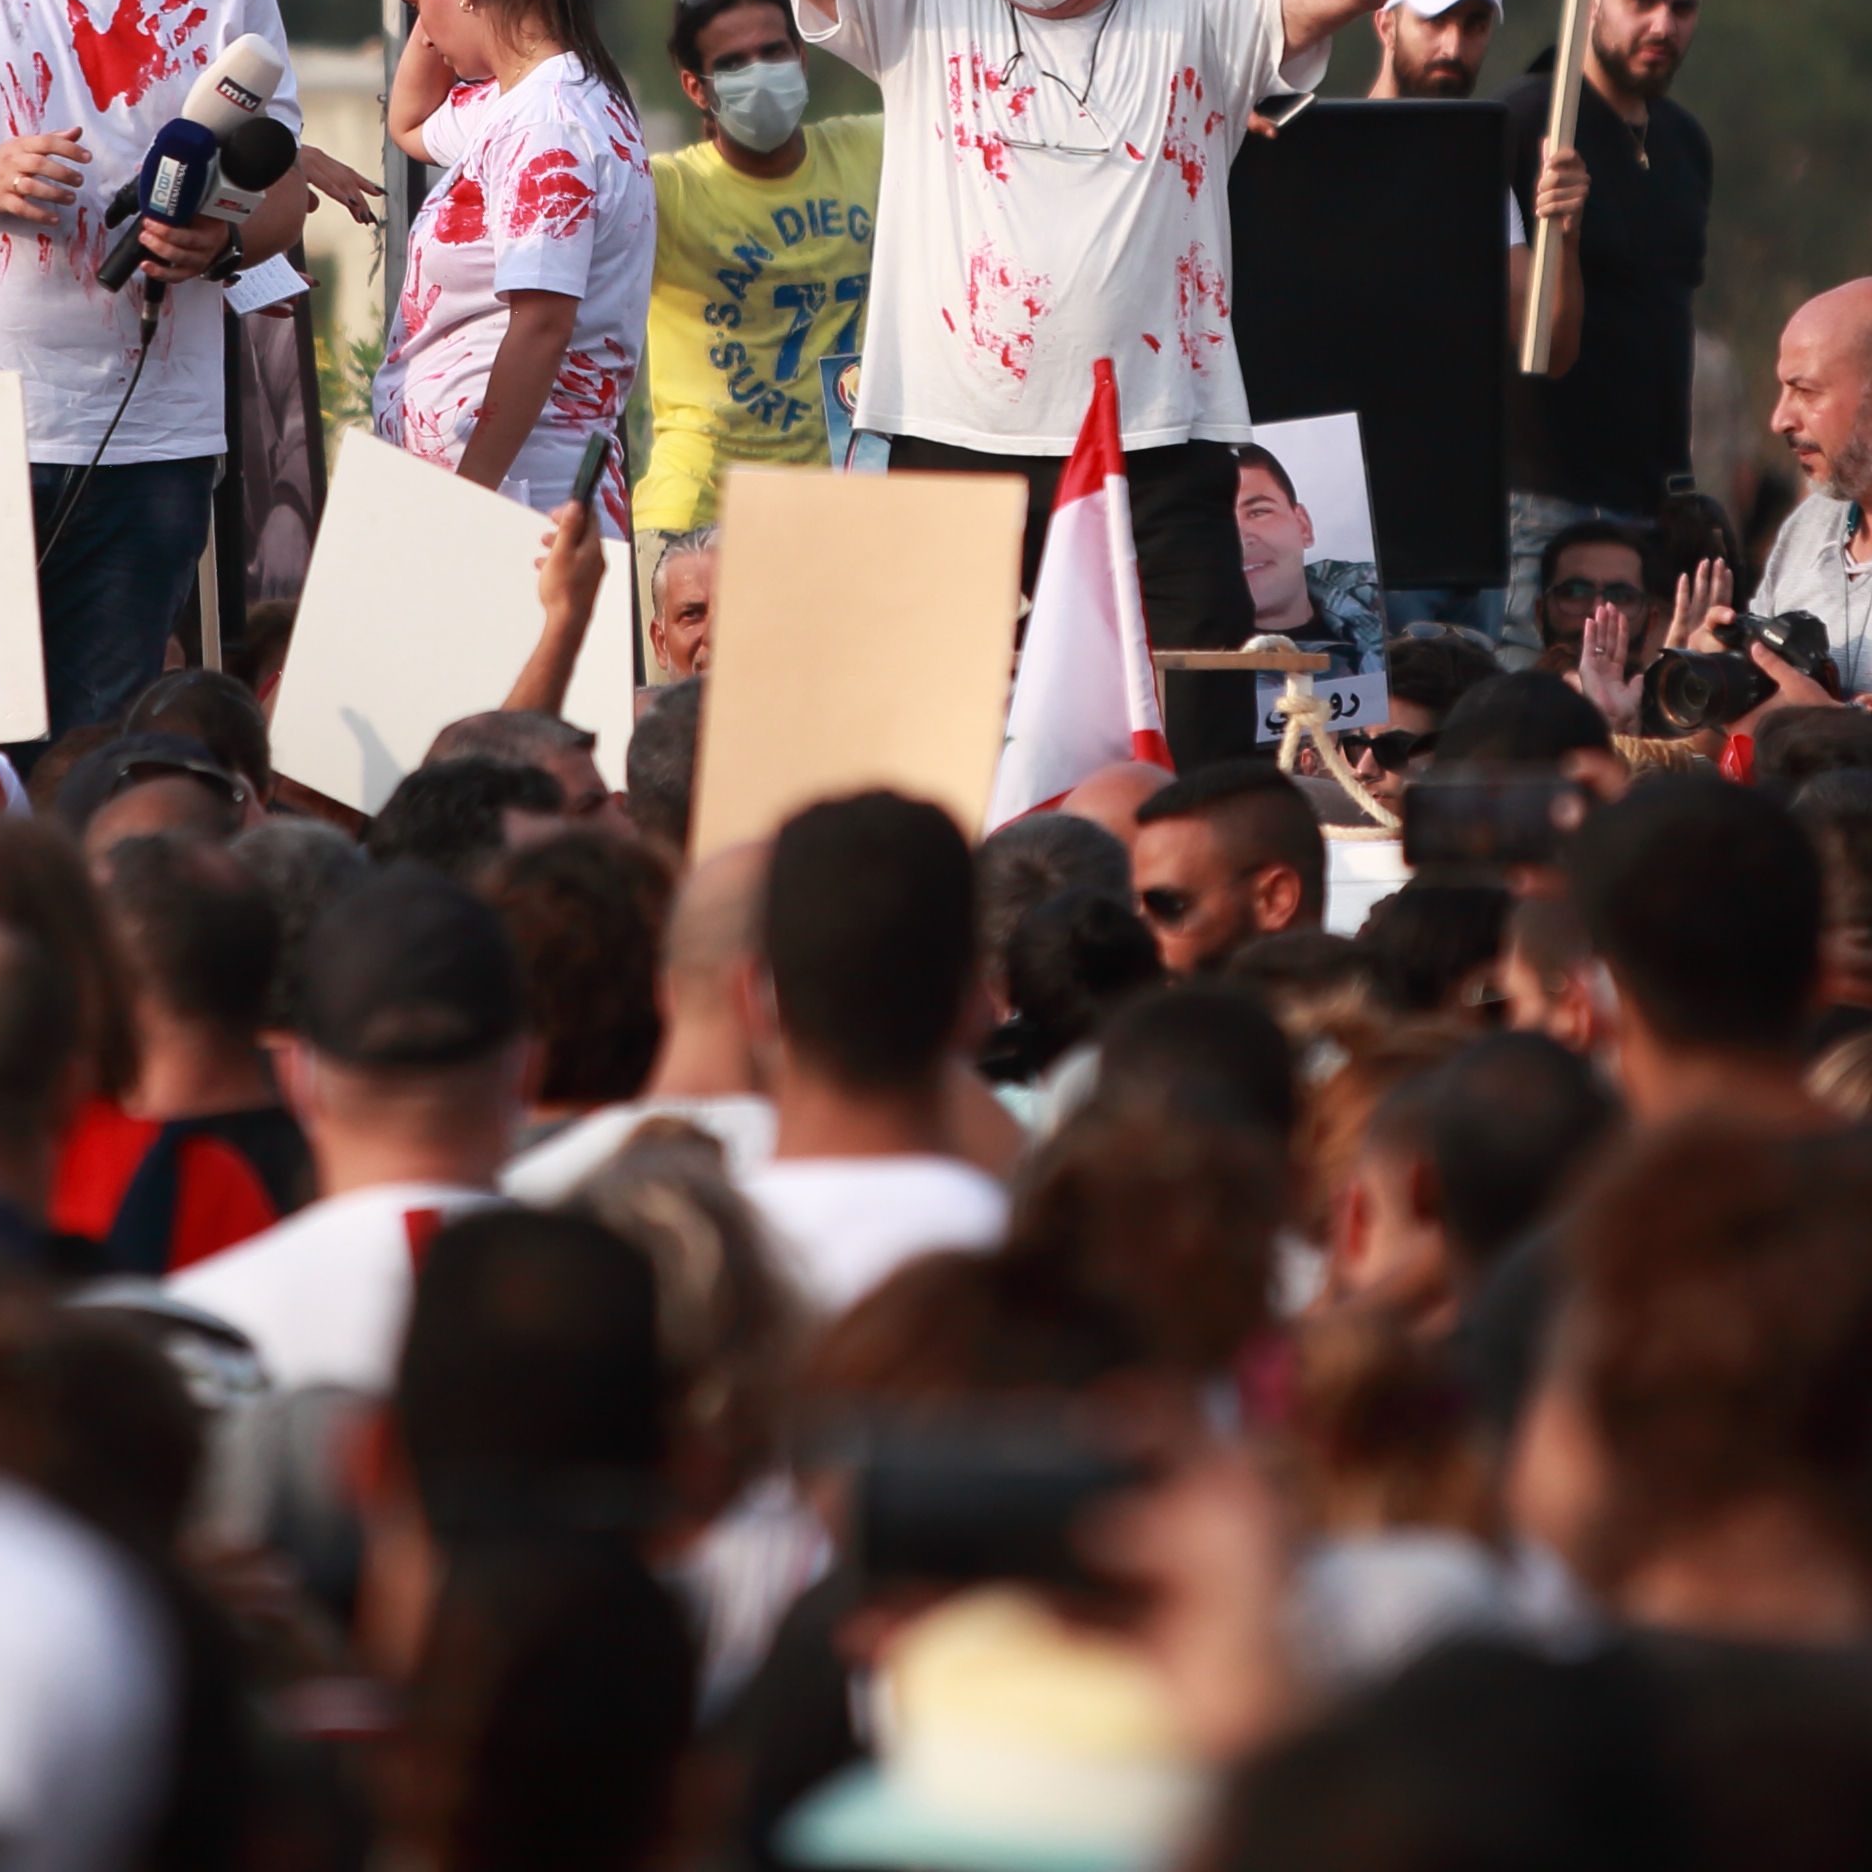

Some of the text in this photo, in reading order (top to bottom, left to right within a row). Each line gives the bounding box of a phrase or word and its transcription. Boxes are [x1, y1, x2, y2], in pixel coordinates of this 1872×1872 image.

[220, 83, 257, 109] mtv
[704, 198, 872, 330] SAN DIEG
[710, 341, 813, 433] SURF
